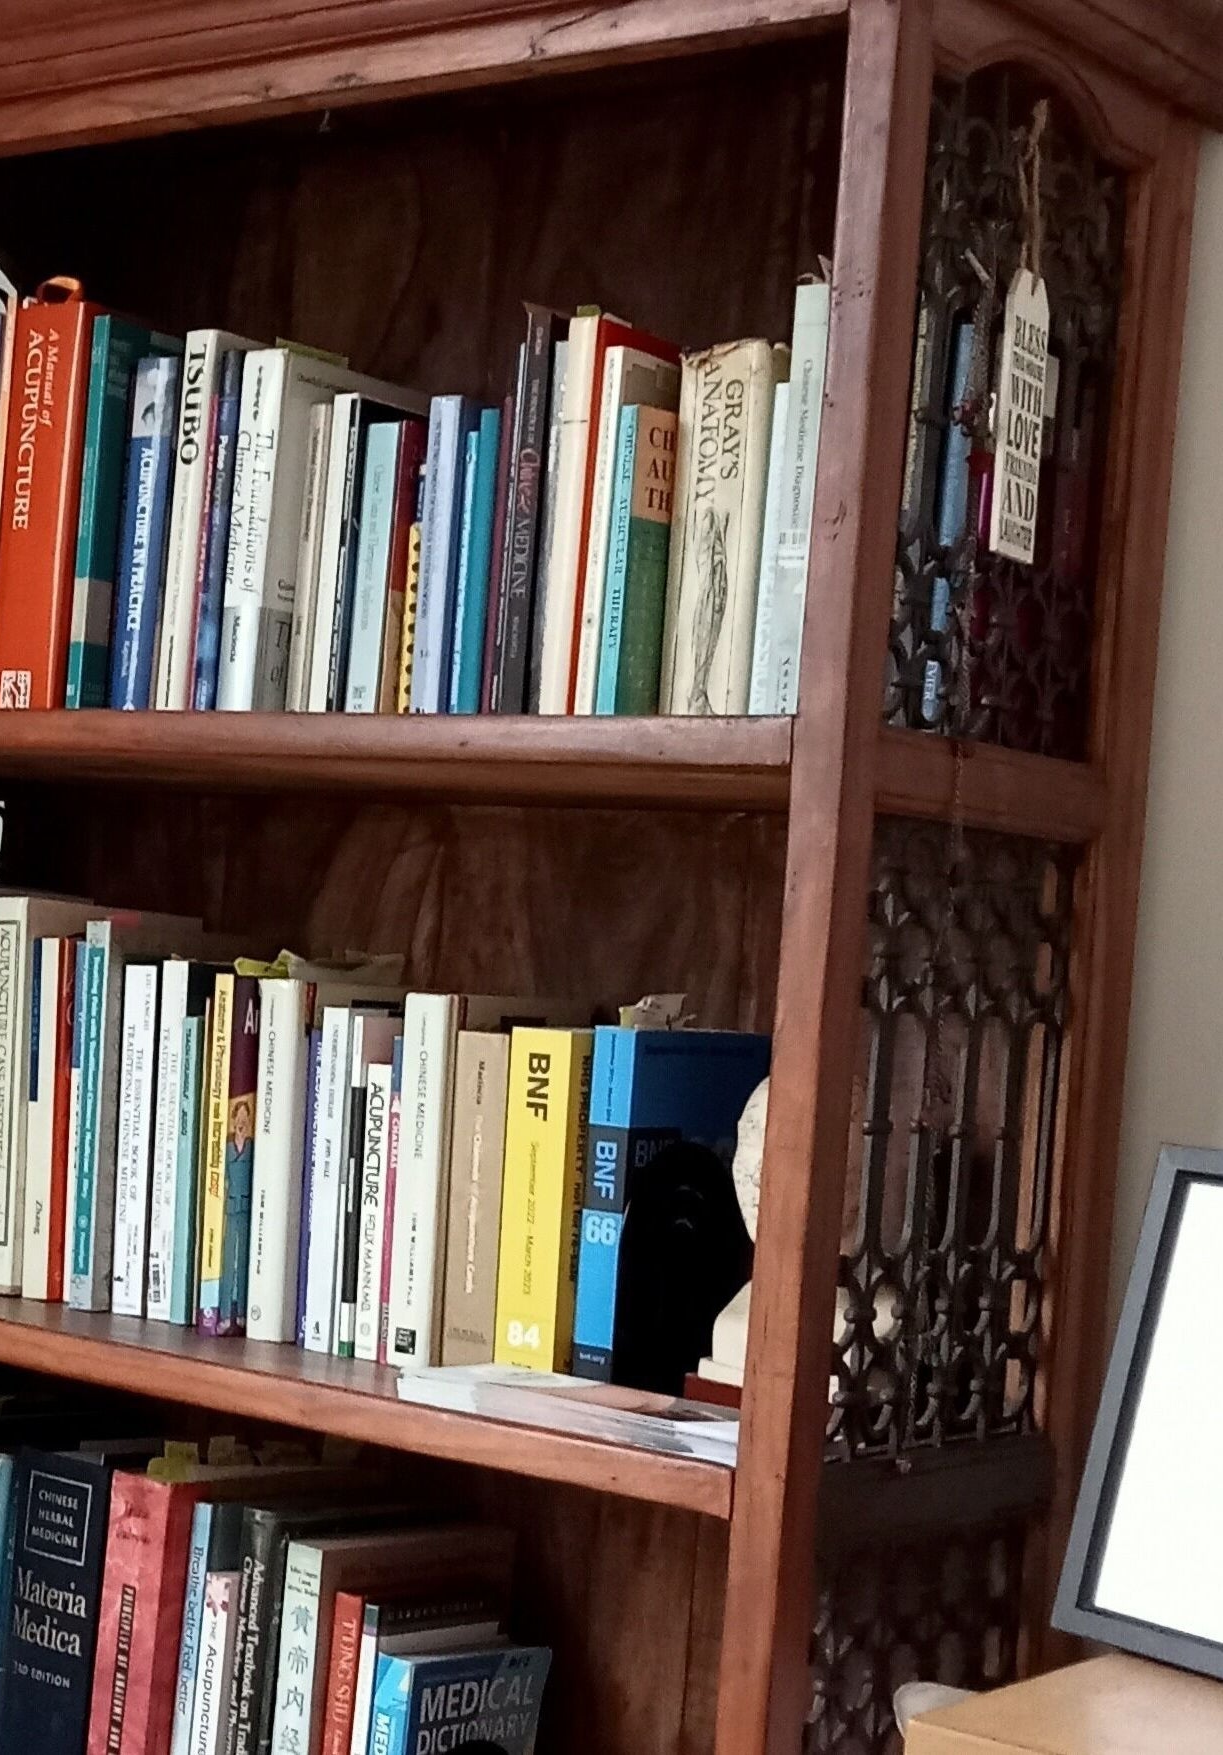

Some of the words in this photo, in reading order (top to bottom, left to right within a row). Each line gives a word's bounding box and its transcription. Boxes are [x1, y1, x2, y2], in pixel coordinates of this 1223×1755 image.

[49, 328, 59, 341] A
[1014, 315, 1047, 362] BLESS
[43, 345, 59, 405] Manual
[801, 359, 814, 406] Chinese
[1011, 373, 1042, 418] WITH
[39, 409, 53, 428] of
[178, 344, 207, 466] TSUBO
[12, 329, 45, 531] ACUPUNCTURE
[215, 434, 229, 470] Pulse
[253, 428, 275, 461] The
[694, 360, 723, 505] ANATOMY
[720, 379, 744, 480] GRAY'S
[795, 408, 809, 463] Medicine
[1008, 408, 1041, 460] LOVE
[516, 447, 541, 515] Chinese
[1003, 450, 1037, 485] FRIENDS
[133, 447, 154, 545] ACUPUNCTURE
[1002, 479, 1035, 522] AND
[244, 468, 270, 575] Foundations
[613, 496, 629, 575] AURICULAR
[132, 549, 147, 565] IN
[510, 517, 531, 599] MEDICINE
[126, 567, 146, 632] PRACTICE
[239, 577, 261, 595] of
[609, 588, 622, 649] THERAPY
[88, 1018, 97, 1038] with
[89, 996, 99, 1016] Pain
[214, 990, 226, 1033] Anatomy
[86, 1040, 97, 1091] Traditional
[122, 1024, 137, 1106] TRADITIONAL
[134, 1048, 145, 1077] THE
[157, 1027, 171, 1110] TRADITIONAL
[168, 1051, 178, 1078] THE
[212, 1045, 225, 1099] Physiology
[264, 1030, 277, 1077] CHINESE
[417, 1049, 429, 1099] CHINESE
[578, 1054, 589, 1088] NHS
[131, 1081, 142, 1139] ESSENTIAL
[261, 1080, 275, 1135] MEDICINE
[526, 1052, 552, 1122] BNF
[166, 1081, 176, 1142] ESSENTIAL
[413, 1102, 427, 1160] MEDICINE
[575, 1091, 588, 1172] PROPERTY
[120, 1110, 132, 1162] CHINESE
[155, 1114, 167, 1165] CHINESE
[210, 1120, 224, 1168] Incredibly
[363, 1081, 386, 1208] ACUPUNCTURE
[389, 1117, 400, 1169] CHAKRAS
[129, 1144, 141, 1180] BOOK
[164, 1149, 174, 1183] BOOK
[527, 1140, 541, 1197] September
[591, 1138, 618, 1201] BNF
[116, 1165, 129, 1225] MEDICINE
[128, 1184, 138, 1202] OF
[152, 1169, 165, 1230] MEDICINE
[162, 1188, 172, 1206] OF
[526, 1198, 537, 1224] 2022
[573, 1180, 583, 1204] not
[32, 1200, 45, 1236] Zhang
[363, 1213, 377, 1245] FELIX
[585, 1214, 618, 1247] 66
[523, 1235, 535, 1267] March
[522, 1269, 534, 1296] 2023
[505, 1319, 542, 1350] 84
[37, 1508, 75, 1529] HERBAL
[38, 1488, 79, 1511] CHINESE
[30, 1525, 78, 1548] MEDICINE
[16, 1565, 87, 1619] Materia
[188, 1546, 205, 1598] Breathe
[239, 1555, 253, 1613] Chinese
[246, 1558, 266, 1630] Advanced
[12, 1603, 82, 1658] Medica
[117, 1585, 136, 1651] PRINCIPLES
[184, 1600, 201, 1640] better
[209, 1619, 218, 1641] THE
[116, 1653, 128, 1669] OF
[181, 1642, 197, 1671] Feel
[232, 1614, 249, 1677] Medicine
[240, 1632, 261, 1698] Textbook
[30, 1667, 71, 1689] EDITION
[110, 1671, 128, 1722] ANATOMY
[177, 1673, 194, 1716] better
[419, 1675, 534, 1724] MEDICAL
[239, 1699, 251, 1718] on
[333, 1683, 356, 1724] SHU
[108, 1724, 122, 1750] AND
[416, 1712, 532, 1755] DICTIONARY
